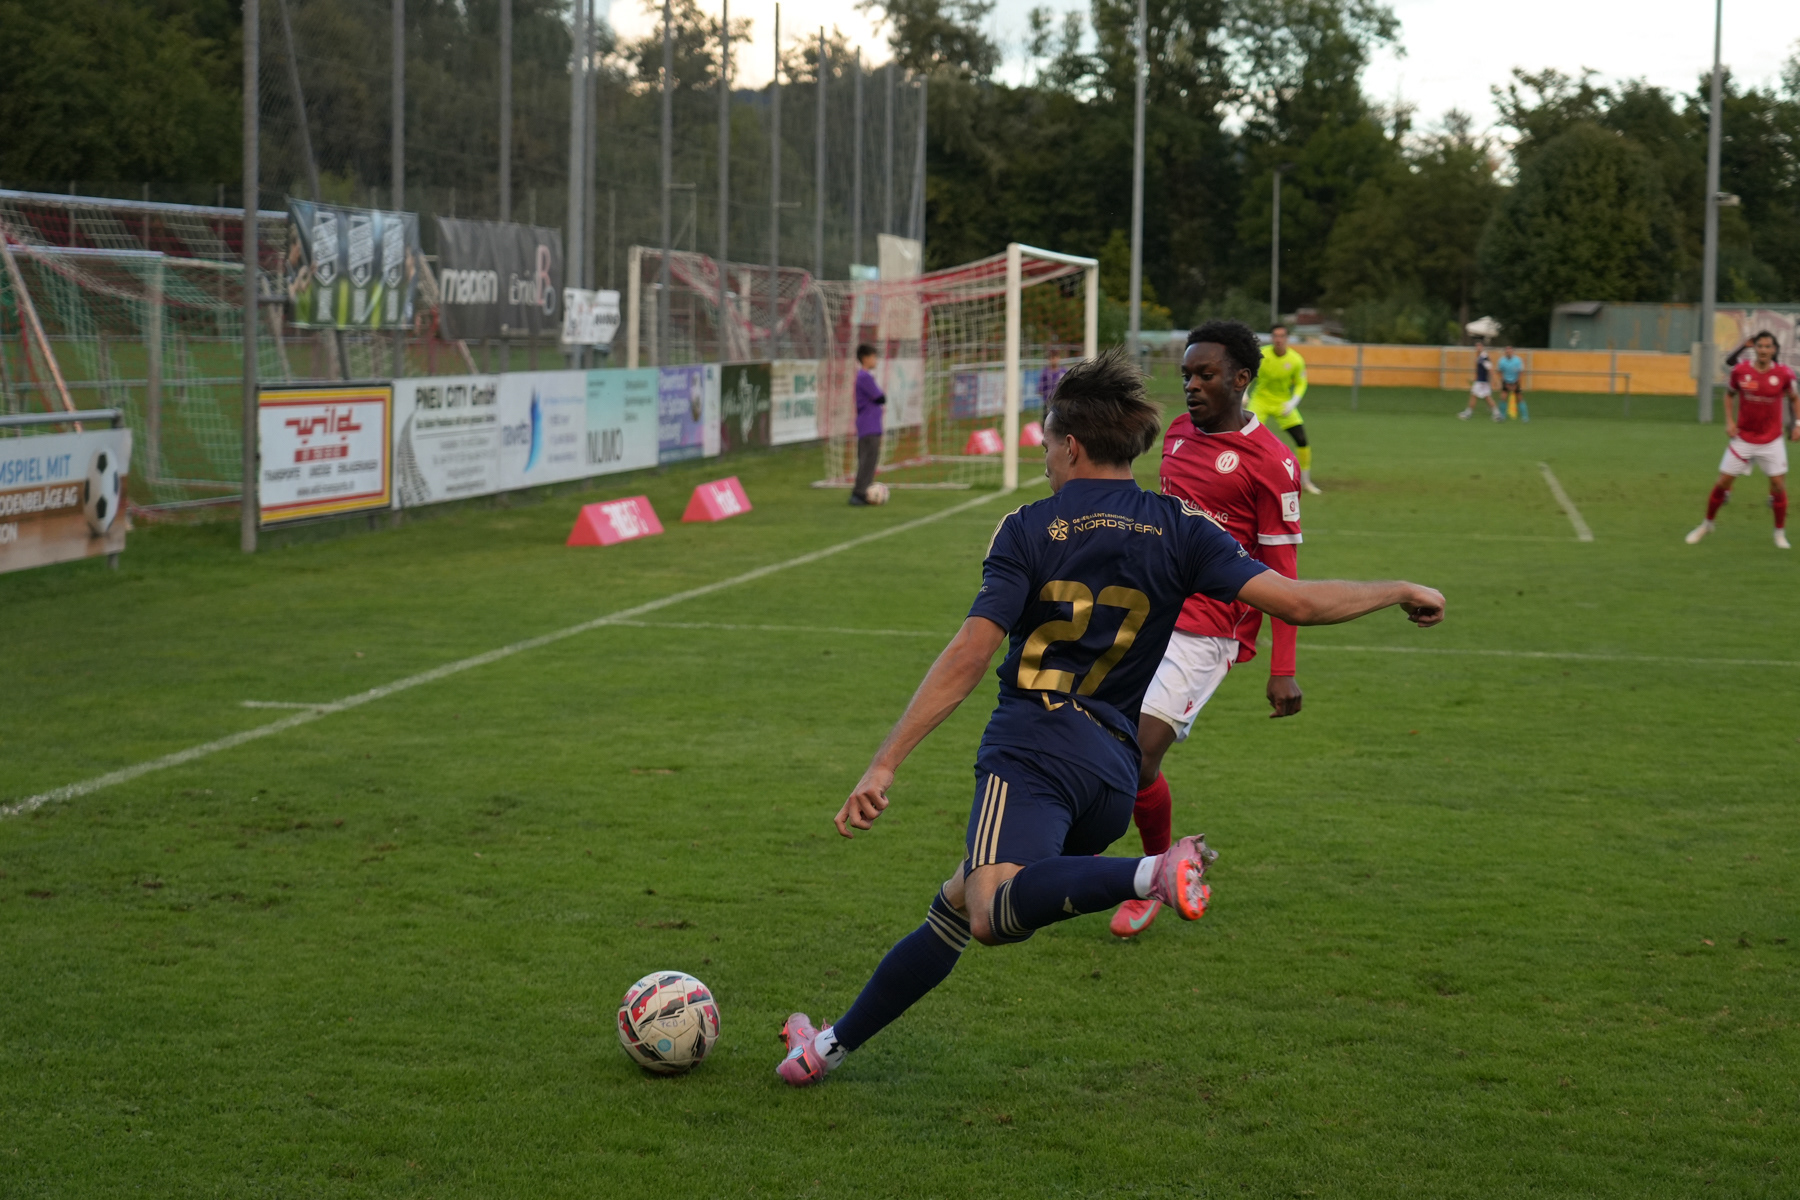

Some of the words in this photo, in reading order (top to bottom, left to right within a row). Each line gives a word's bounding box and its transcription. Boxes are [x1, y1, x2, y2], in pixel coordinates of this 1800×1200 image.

[416, 386, 442, 410] PNEU
[446, 384, 468, 407] CITY
[46, 453, 71, 478] MIT
[64, 486, 78, 507] AG
[1074, 519, 1163, 536] NORDSTERN
[1214, 511, 1229, 523] AG
[1016, 579, 1151, 697] 27
